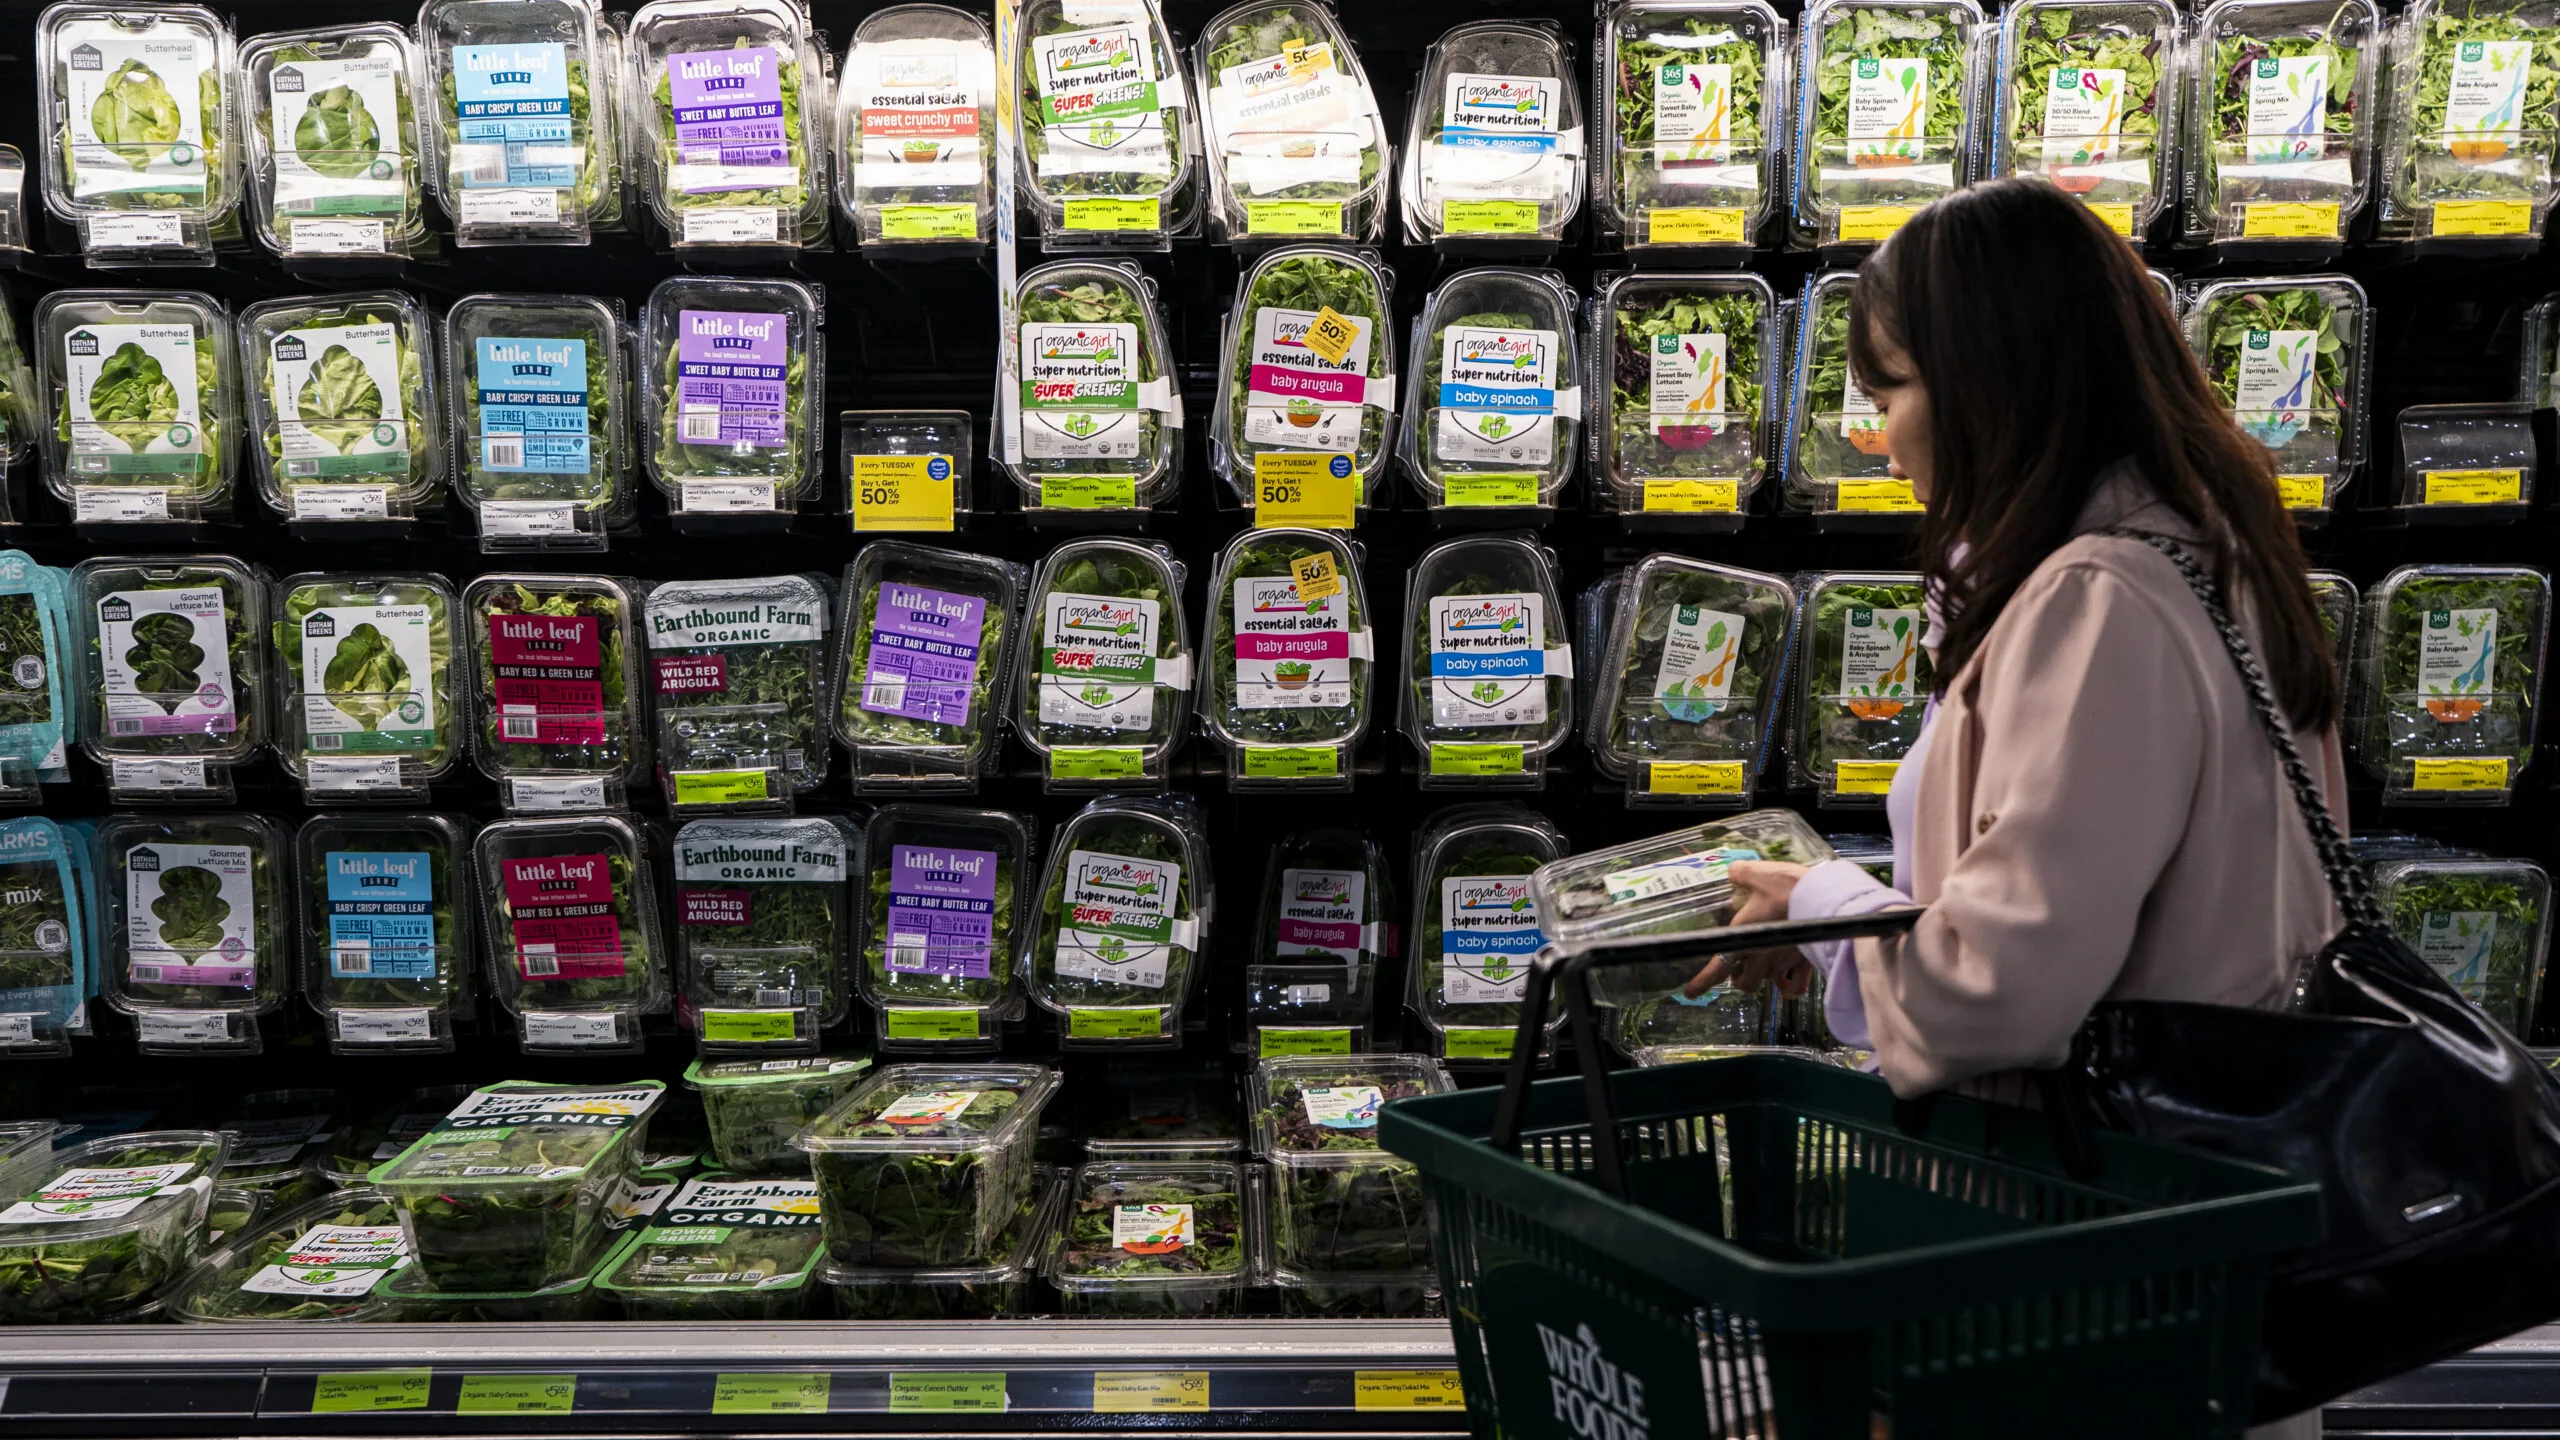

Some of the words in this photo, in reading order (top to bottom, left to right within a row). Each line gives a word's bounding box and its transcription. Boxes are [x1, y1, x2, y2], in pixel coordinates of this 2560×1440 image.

[144, 43, 193, 53] Butterhead
[2462, 43, 2481, 56] 365
[72, 53, 101, 62] GOTHAM
[467, 52, 509, 73] little
[515, 49, 552, 75] leaf
[73, 61, 101, 70] GREENS
[681, 59, 723, 79] little
[728, 55, 765, 79] leaf
[2259, 61, 2278, 74] 365
[1664, 67, 1682, 80] 365
[2059, 70, 2077, 83] 365
[706, 79, 745, 91] FARMS
[1049, 76, 1083, 92] super
[2456, 81, 2474, 90] Baby
[2475, 81, 2498, 90] Arugula
[872, 95, 926, 106] essential
[2255, 97, 2276, 107] Spring
[2277, 97, 2290, 105] Mix
[465, 103, 486, 115] BABY
[488, 102, 515, 115] CRISPY
[517, 101, 542, 113] GREEN
[543, 101, 562, 113] LEAF
[681, 111, 705, 123] SWEET
[707, 109, 727, 121] BABY
[729, 107, 757, 119] BUTTER
[758, 105, 777, 116] LEAF
[1660, 104, 1679, 112] Sweet
[1680, 104, 1697, 113] Baby
[2052, 108, 2071, 116] 50/50
[2072, 107, 2091, 115] Blend
[867, 114, 904, 128] sweet
[905, 113, 950, 129] crunchy
[953, 112, 974, 126] mix
[1453, 112, 1486, 127] super
[1660, 111, 1688, 120] Lettuces
[1457, 135, 1486, 149] baby
[1488, 136, 1541, 150] spinach
[140, 329, 189, 338] Butterhead
[692, 317, 733, 335] little
[738, 319, 774, 342] leaf
[71, 340, 97, 348] GOTHAM
[716, 338, 750, 348] FARMS
[1659, 337, 1677, 350] 365
[72, 346, 98, 355] GREENS
[1262, 351, 1315, 368] essential
[685, 364, 709, 375] SWEET
[711, 365, 731, 376] BABY
[733, 366, 760, 378] BUTTER
[762, 367, 780, 379] LEAF
[1032, 365, 1065, 380] super
[1452, 368, 1484, 384] super
[1676, 372, 1693, 381] Baby
[1271, 374, 1298, 391] baby
[1300, 378, 1344, 396] arugula
[1656, 378, 1683, 386] Lettuces
[700, 383, 720, 395] FREE
[744, 390, 780, 401] GROWN
[1455, 390, 1488, 407] baby
[1490, 392, 1538, 409] spinach
[861, 488, 900, 505] 50%
[1262, 486, 1302, 503] 50%
[180, 593, 218, 602] Gourmet
[104, 606, 131, 614] GOTHAM
[170, 601, 204, 610] Lettuce
[206, 601, 219, 609] Mix
[104, 612, 131, 621] GREENS
[653, 605, 760, 634] Earthbound
[766, 605, 813, 626] Farm
[1679, 609, 1698, 622] 365
[1244, 617, 1297, 631] essential
[503, 622, 544, 641] little
[549, 623, 585, 645] leaf
[695, 629, 771, 643] ORGANIC
[1256, 639, 1284, 655] baby
[1285, 638, 1328, 654] arugula
[1440, 636, 1472, 652] super
[1670, 640, 1686, 650] Baby
[1687, 642, 1701, 652] Kale
[1446, 656, 1479, 673] baby
[1480, 655, 1529, 671] spinach
[500, 666, 520, 677] BABY
[522, 667, 538, 678] RED
[540, 667, 547, 678] &
[548, 668, 573, 680] GREEN
[575, 668, 594, 680] LEAF
[660, 667, 693, 678] WILD
[695, 666, 719, 676] RED
[661, 677, 720, 689] ARUGULA
[682, 845, 787, 867] Earthbound
[792, 845, 836, 867] Farm
[721, 865, 796, 878] ORGANIC
[5, 887, 42, 906] mix
[1074, 889, 1106, 904] super
[687, 900, 720, 911] WILD
[721, 901, 744, 911] RED
[687, 911, 744, 922] ARUGULA
[480, 1090, 651, 1106] Earthbound
[468, 1103, 544, 1115] Farm
[451, 1114, 628, 1127] ORGANIC
[694, 1186, 819, 1198] Earthbou
[686, 1195, 758, 1208] Farm
[660, 1228, 718, 1236] POWER
[1536, 1322, 1650, 1429] WHOLE
[1548, 1376, 1649, 1440] FOOD
